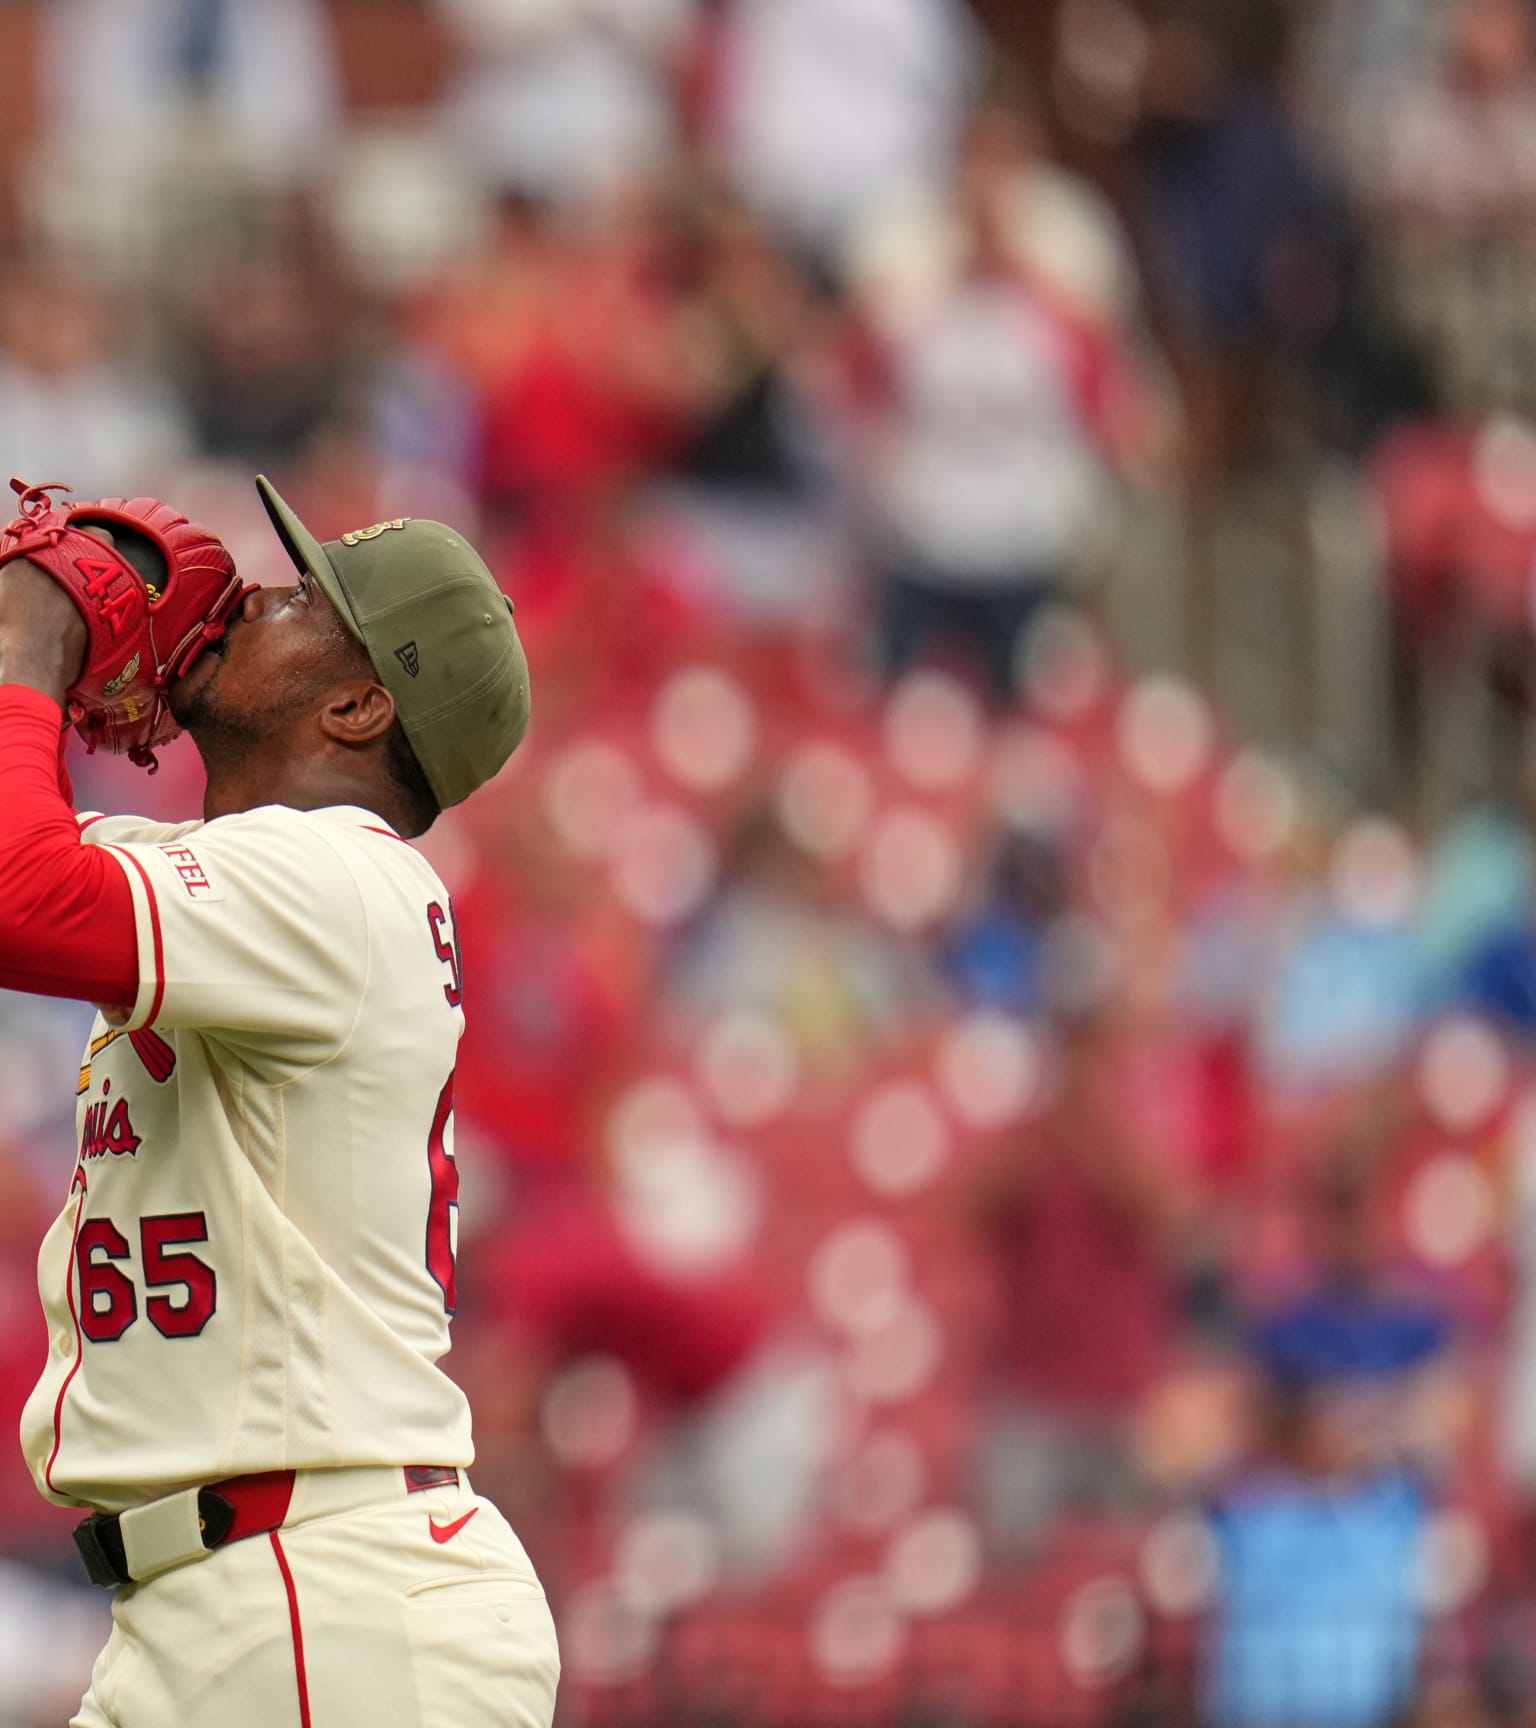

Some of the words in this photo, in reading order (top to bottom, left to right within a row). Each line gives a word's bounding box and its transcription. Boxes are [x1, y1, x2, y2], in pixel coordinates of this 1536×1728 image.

[158, 843, 211, 897] IFEL
[424, 1066, 460, 1318] 6
[76, 1211, 217, 1343] 65
